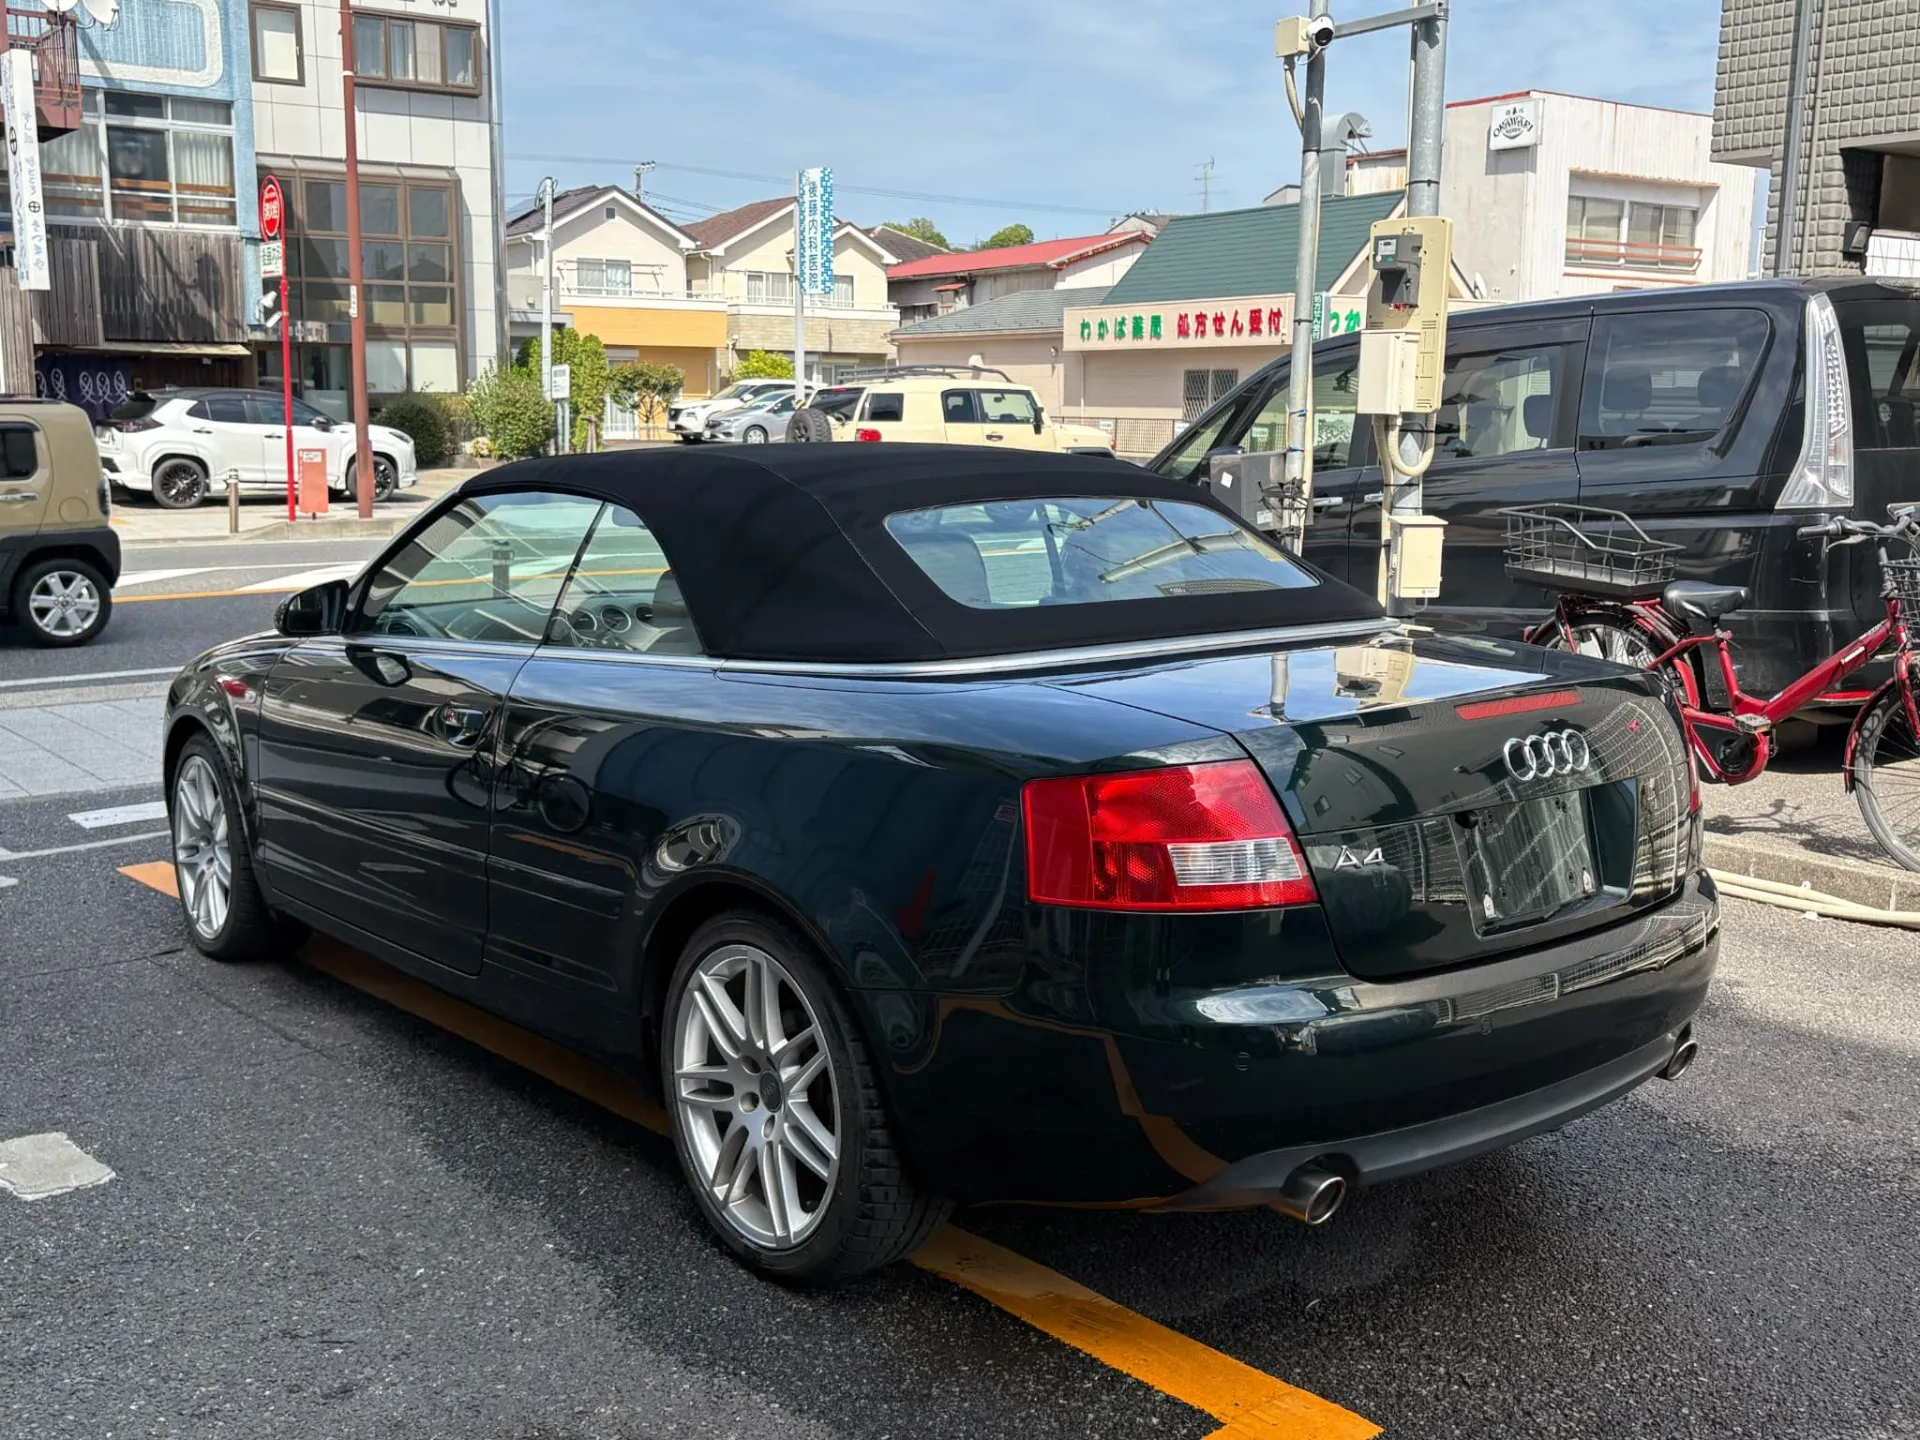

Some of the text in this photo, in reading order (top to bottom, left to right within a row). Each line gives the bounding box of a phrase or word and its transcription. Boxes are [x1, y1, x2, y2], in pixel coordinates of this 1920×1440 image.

[1080, 307, 1282, 341] わかば薬局 処方せん受付
[1332, 845, 1385, 871] A4
